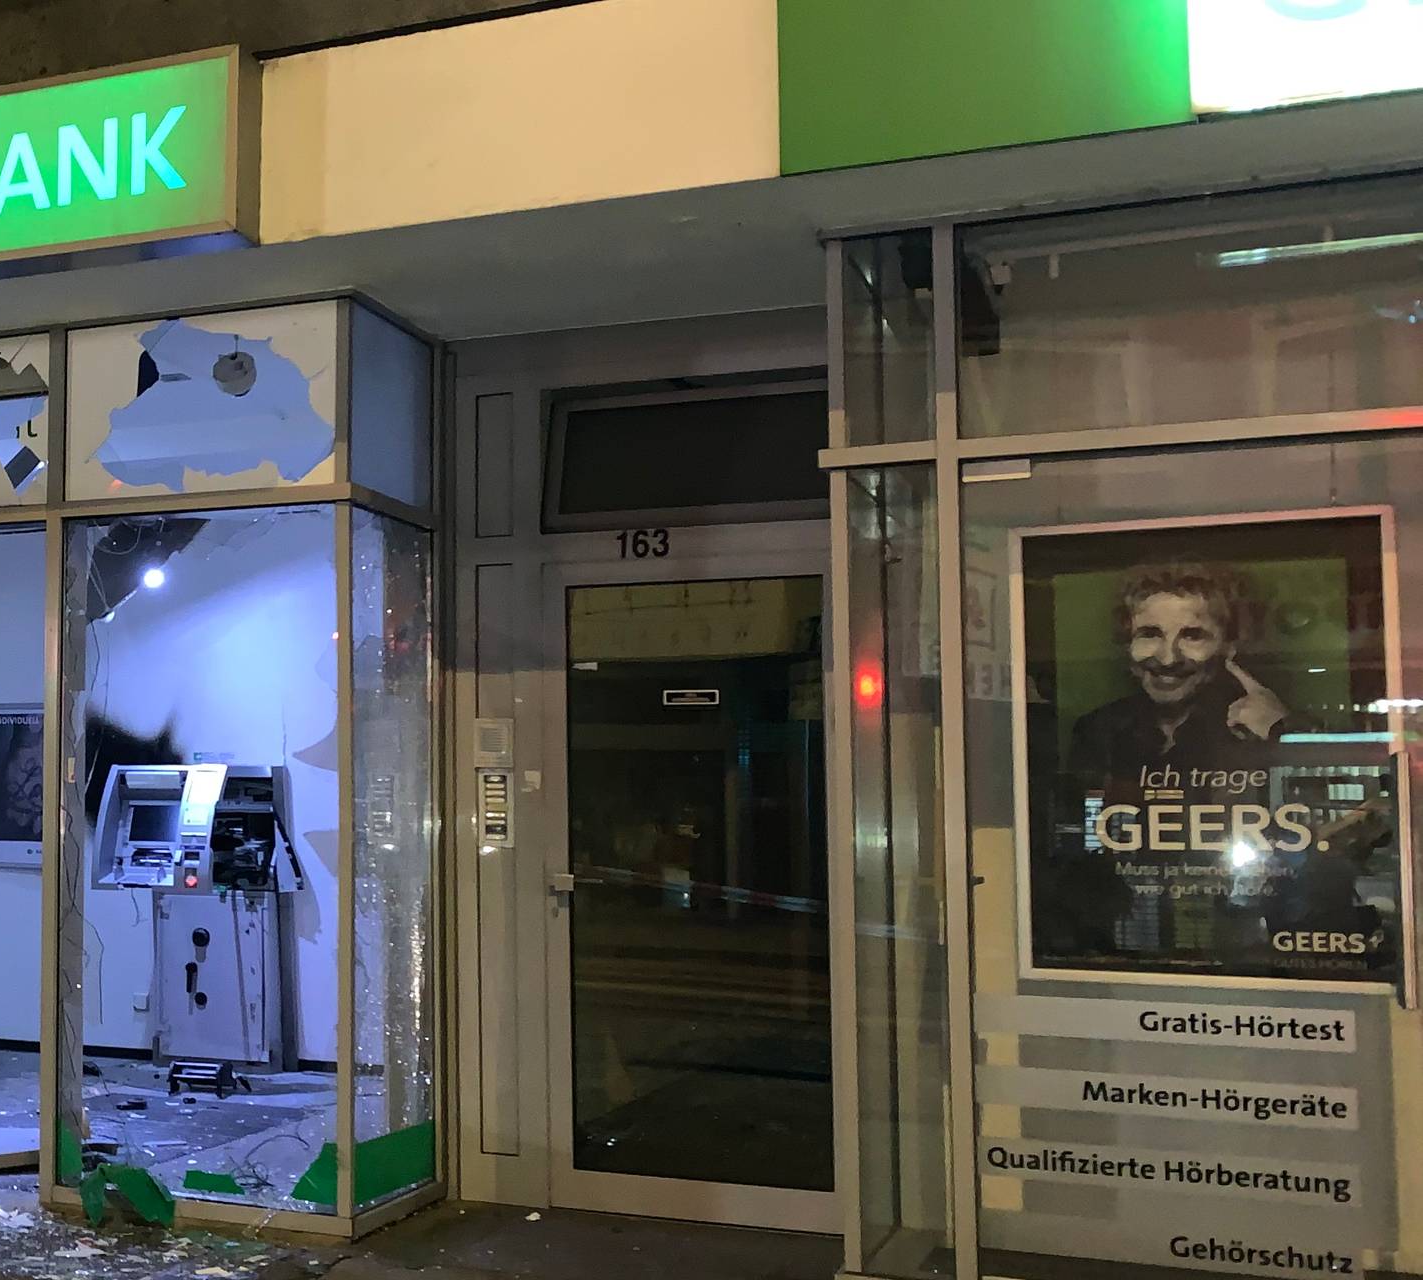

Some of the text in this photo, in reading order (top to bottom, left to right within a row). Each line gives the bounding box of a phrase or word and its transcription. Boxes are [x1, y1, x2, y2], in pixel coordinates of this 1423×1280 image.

[616, 528, 671, 559] 163
[1140, 763, 1268, 794] Ich trage
[1272, 931, 1367, 954] GEERS
[1139, 1010, 1346, 1042] Gratis-Hörtest
[1082, 1080, 1348, 1120] Marken-Hörgeräte
[987, 1146, 1352, 1202] Qualifizierte Hörberatung
[1170, 1236, 1353, 1273] Gehörschutz
